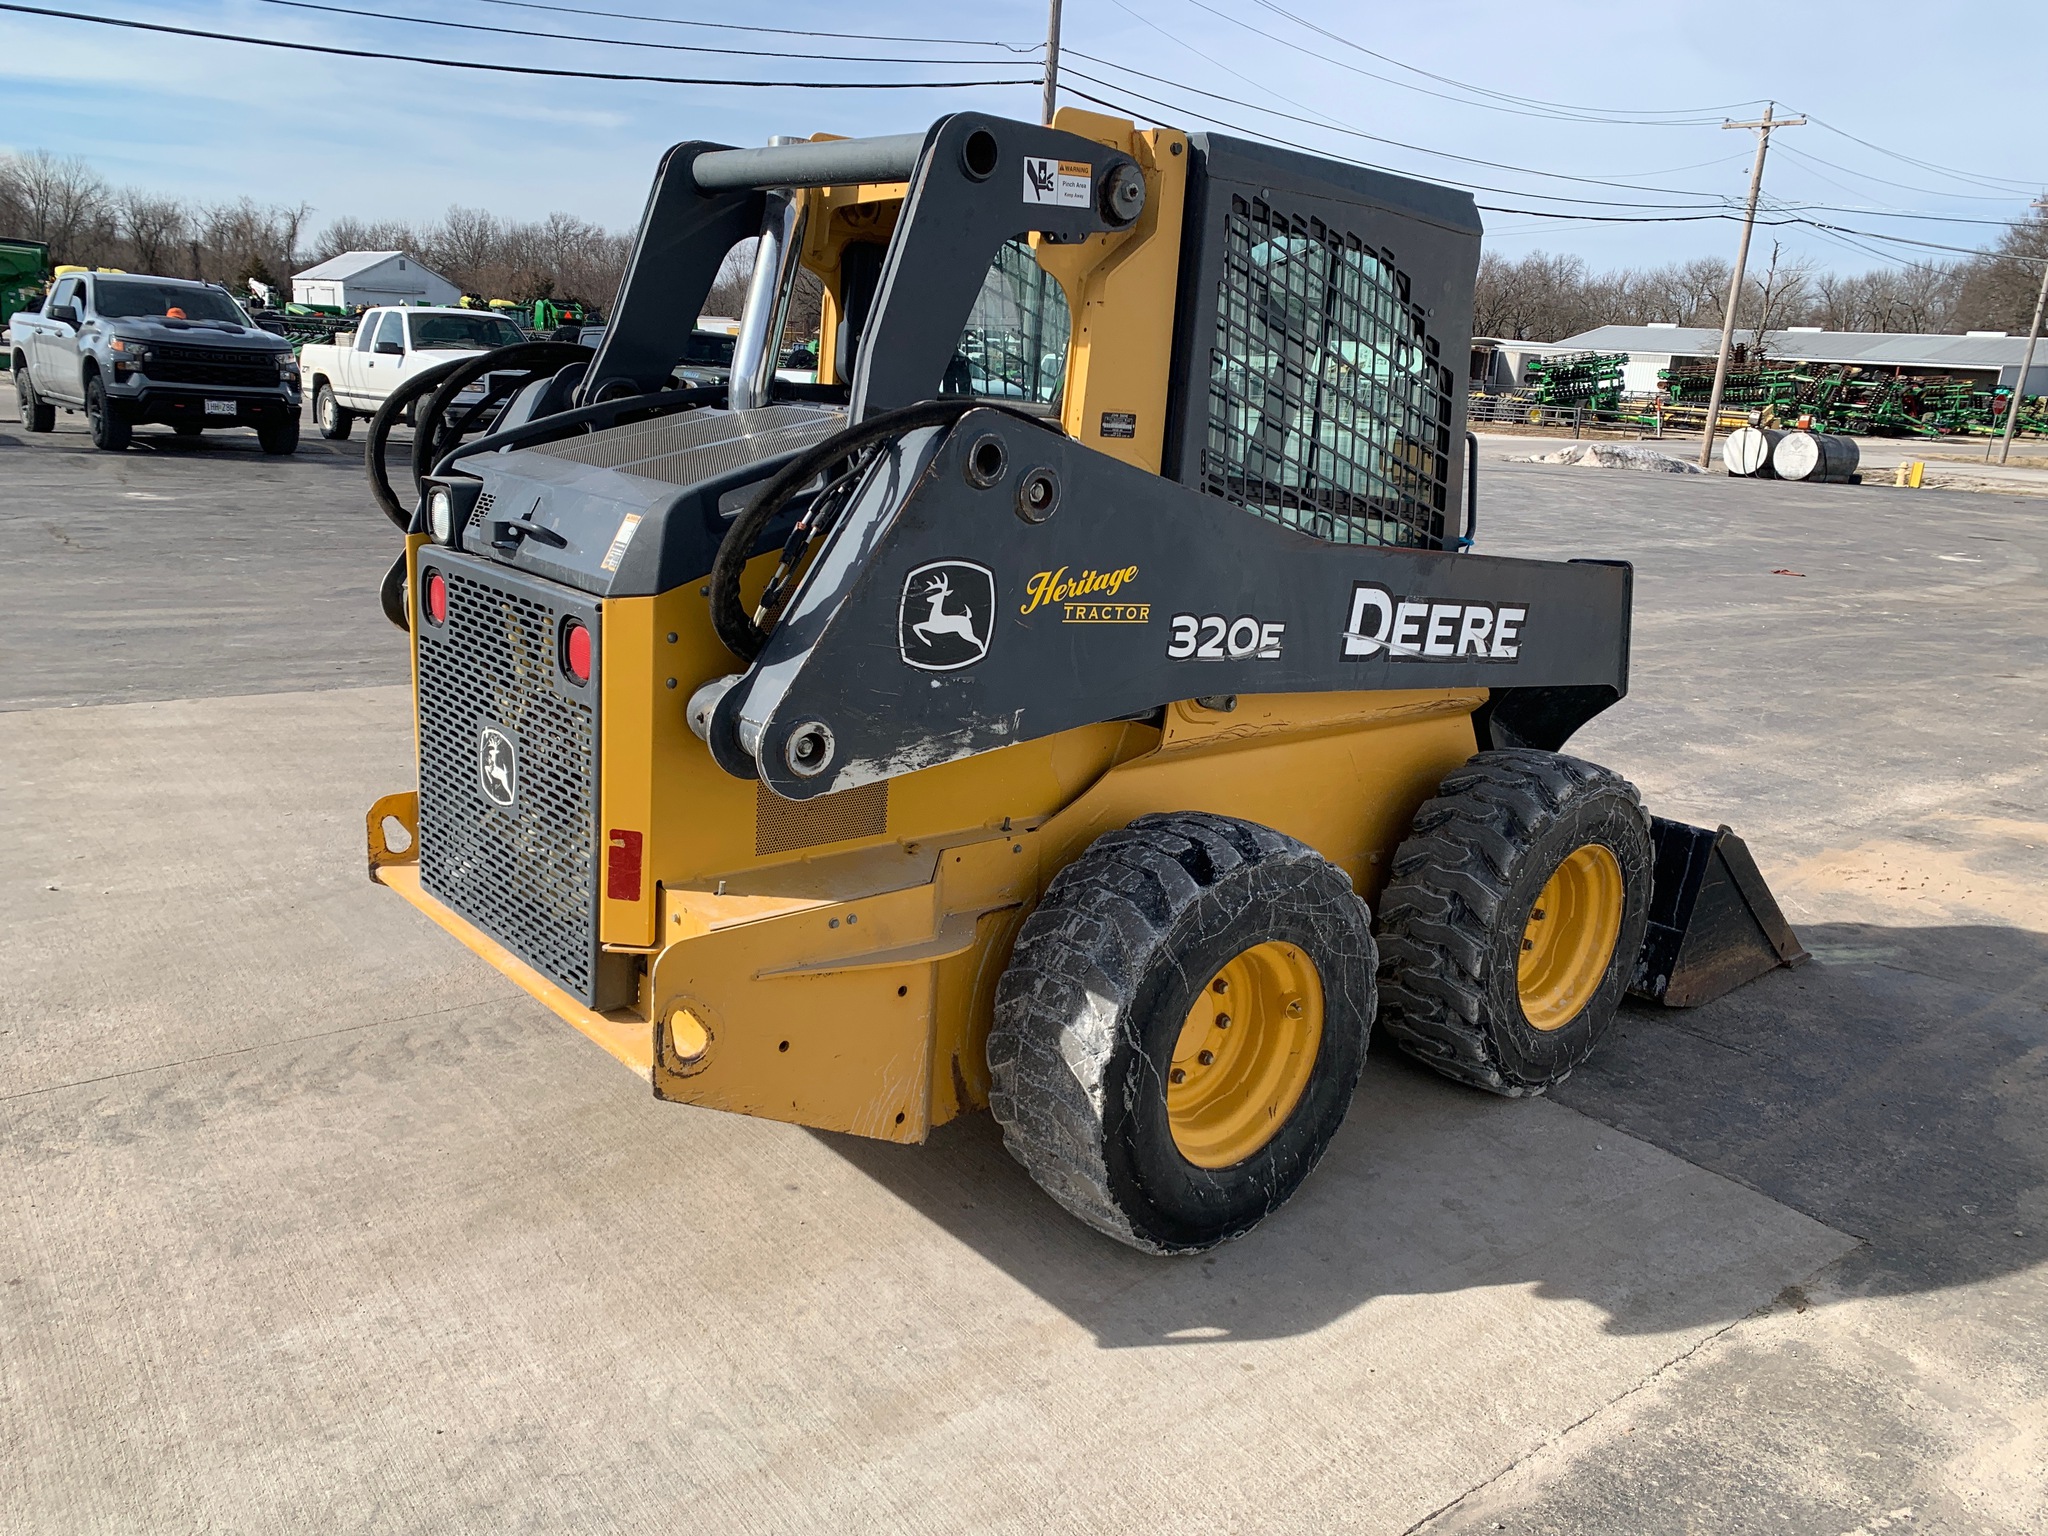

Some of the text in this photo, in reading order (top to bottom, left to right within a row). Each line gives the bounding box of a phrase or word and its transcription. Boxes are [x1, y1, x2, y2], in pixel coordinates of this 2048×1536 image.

[1065, 165, 1089, 173] WARNING
[1020, 565, 1139, 615] Heritage
[1063, 606, 1150, 620] TRACTOR
[1167, 614, 1286, 660] 320E
[1344, 587, 1527, 659] DEERE
